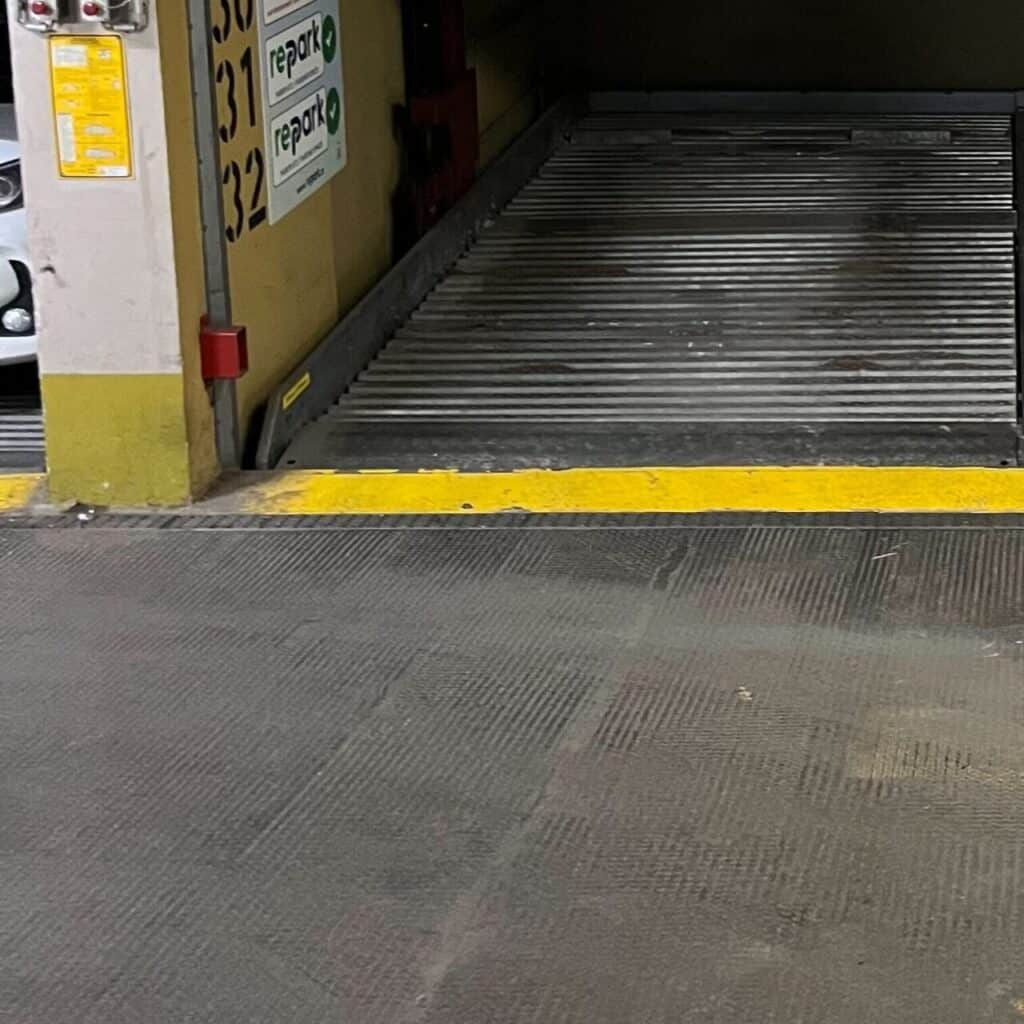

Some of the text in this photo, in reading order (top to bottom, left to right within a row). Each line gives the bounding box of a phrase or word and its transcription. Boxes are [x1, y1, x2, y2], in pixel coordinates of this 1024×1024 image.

[270, 19, 321, 79] repark
[215, 46, 256, 144] 31
[275, 94, 325, 157] repark
[223, 147, 266, 243] 32
